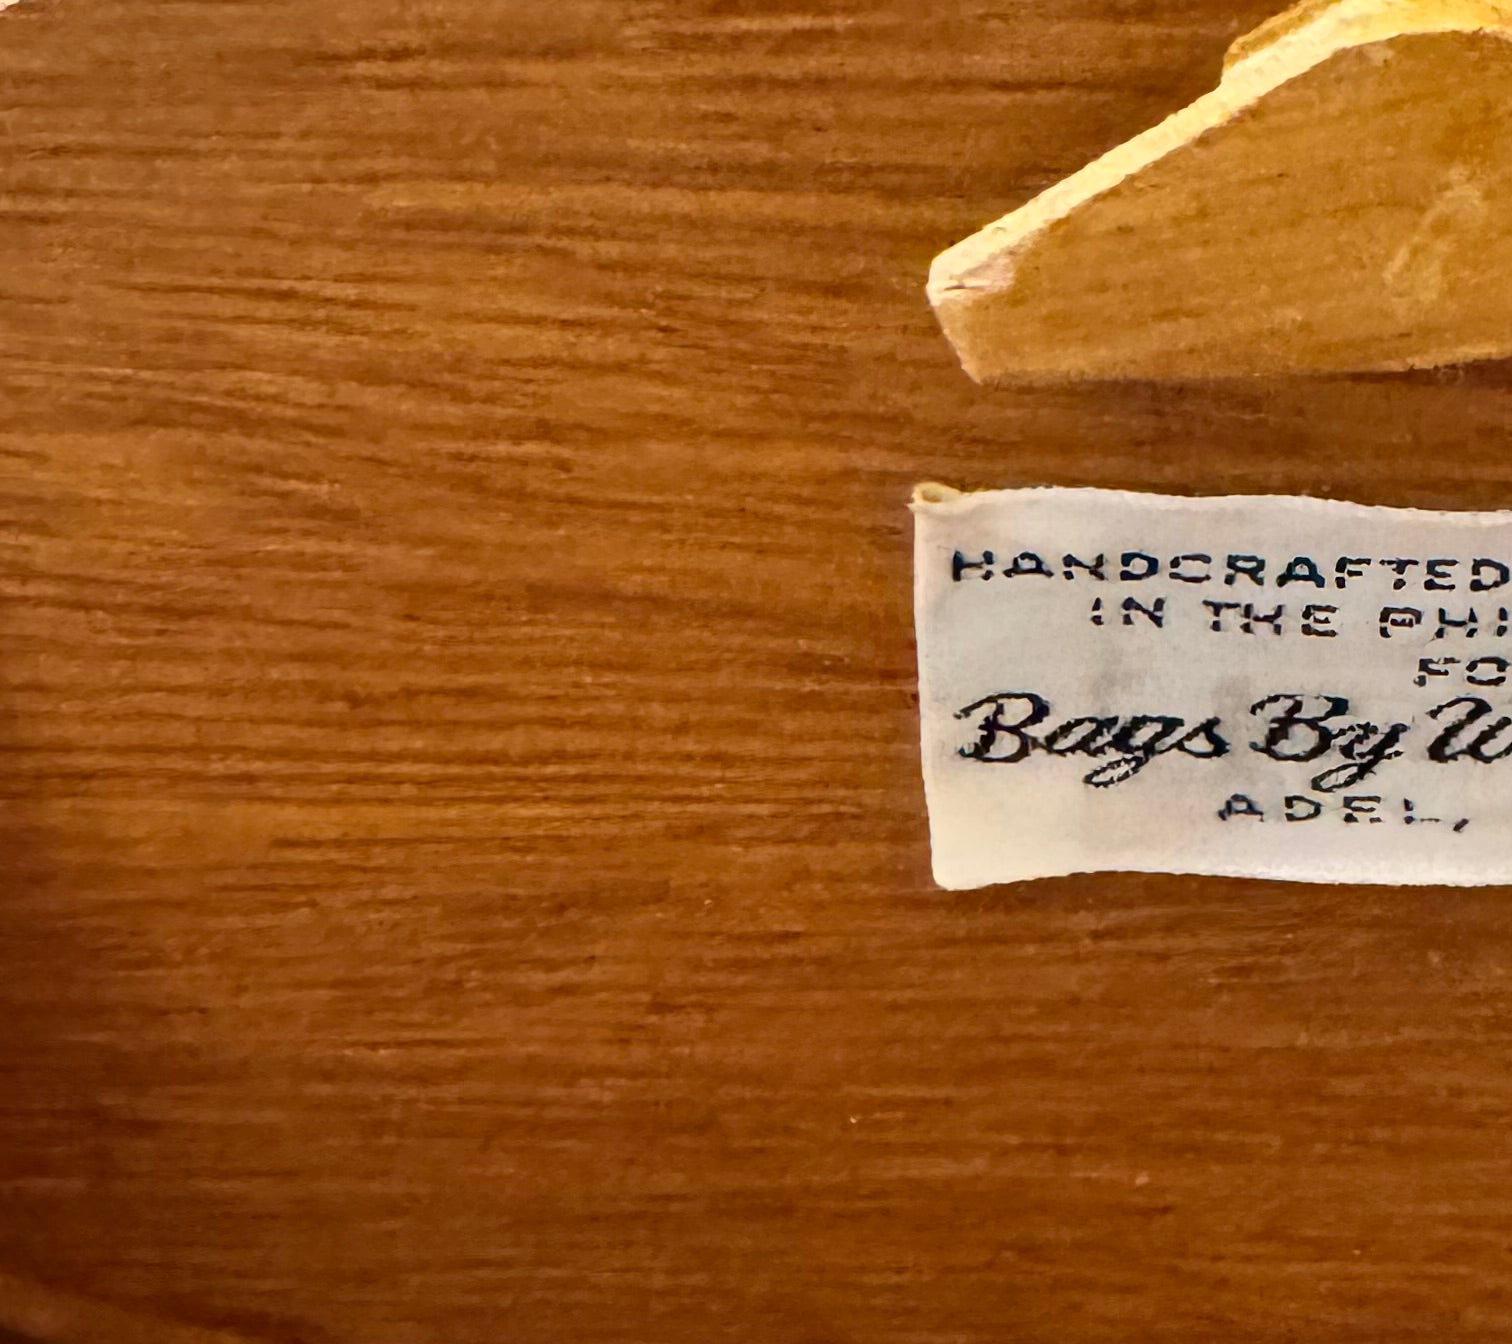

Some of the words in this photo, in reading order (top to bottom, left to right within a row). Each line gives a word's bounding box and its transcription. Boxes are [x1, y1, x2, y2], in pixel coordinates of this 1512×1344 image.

[952, 550, 1510, 592] HANDCRAFTED
[1090, 596, 1168, 628] IN
[1201, 598, 1340, 638] THE
[952, 689, 1231, 788] Bags
[1249, 693, 1408, 793] By
[1217, 793, 1470, 833] ADEL,
